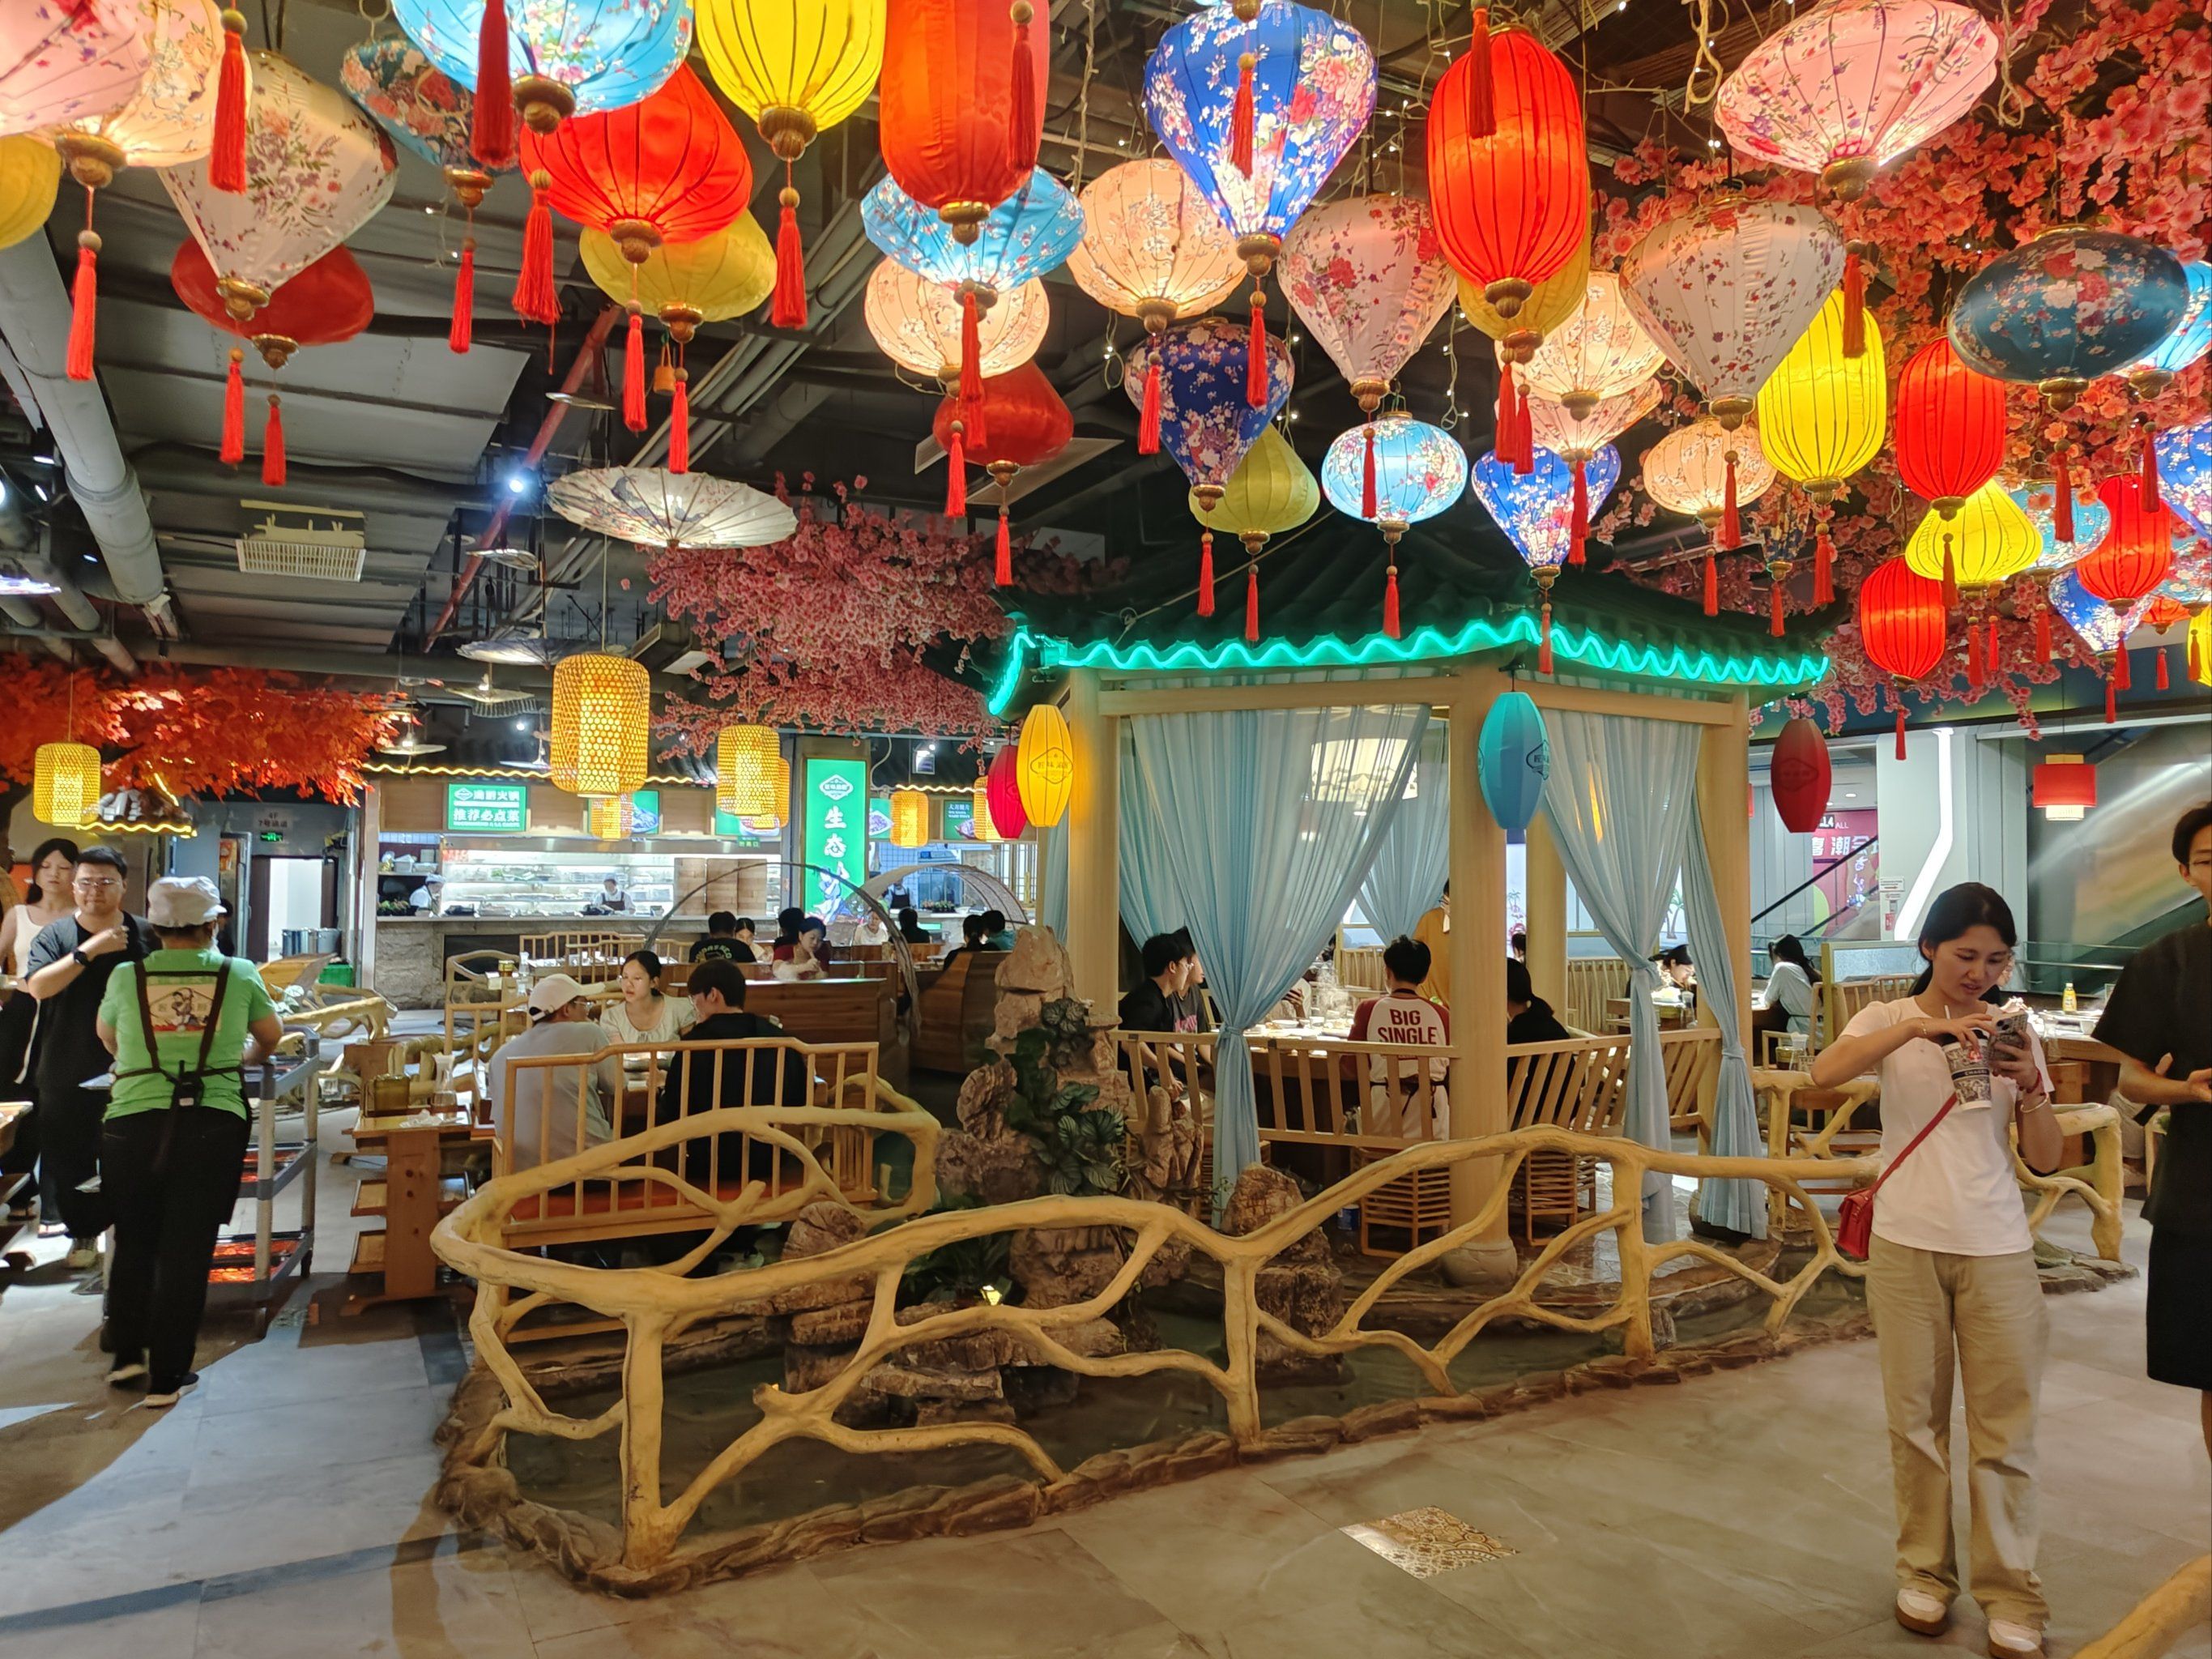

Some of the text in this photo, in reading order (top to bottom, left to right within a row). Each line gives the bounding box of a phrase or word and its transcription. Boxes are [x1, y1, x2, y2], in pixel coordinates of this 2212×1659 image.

[824, 805, 847, 858] 生态
[1389, 1009, 1421, 1026] BIG
[1378, 1026, 1438, 1045] SINGLE
